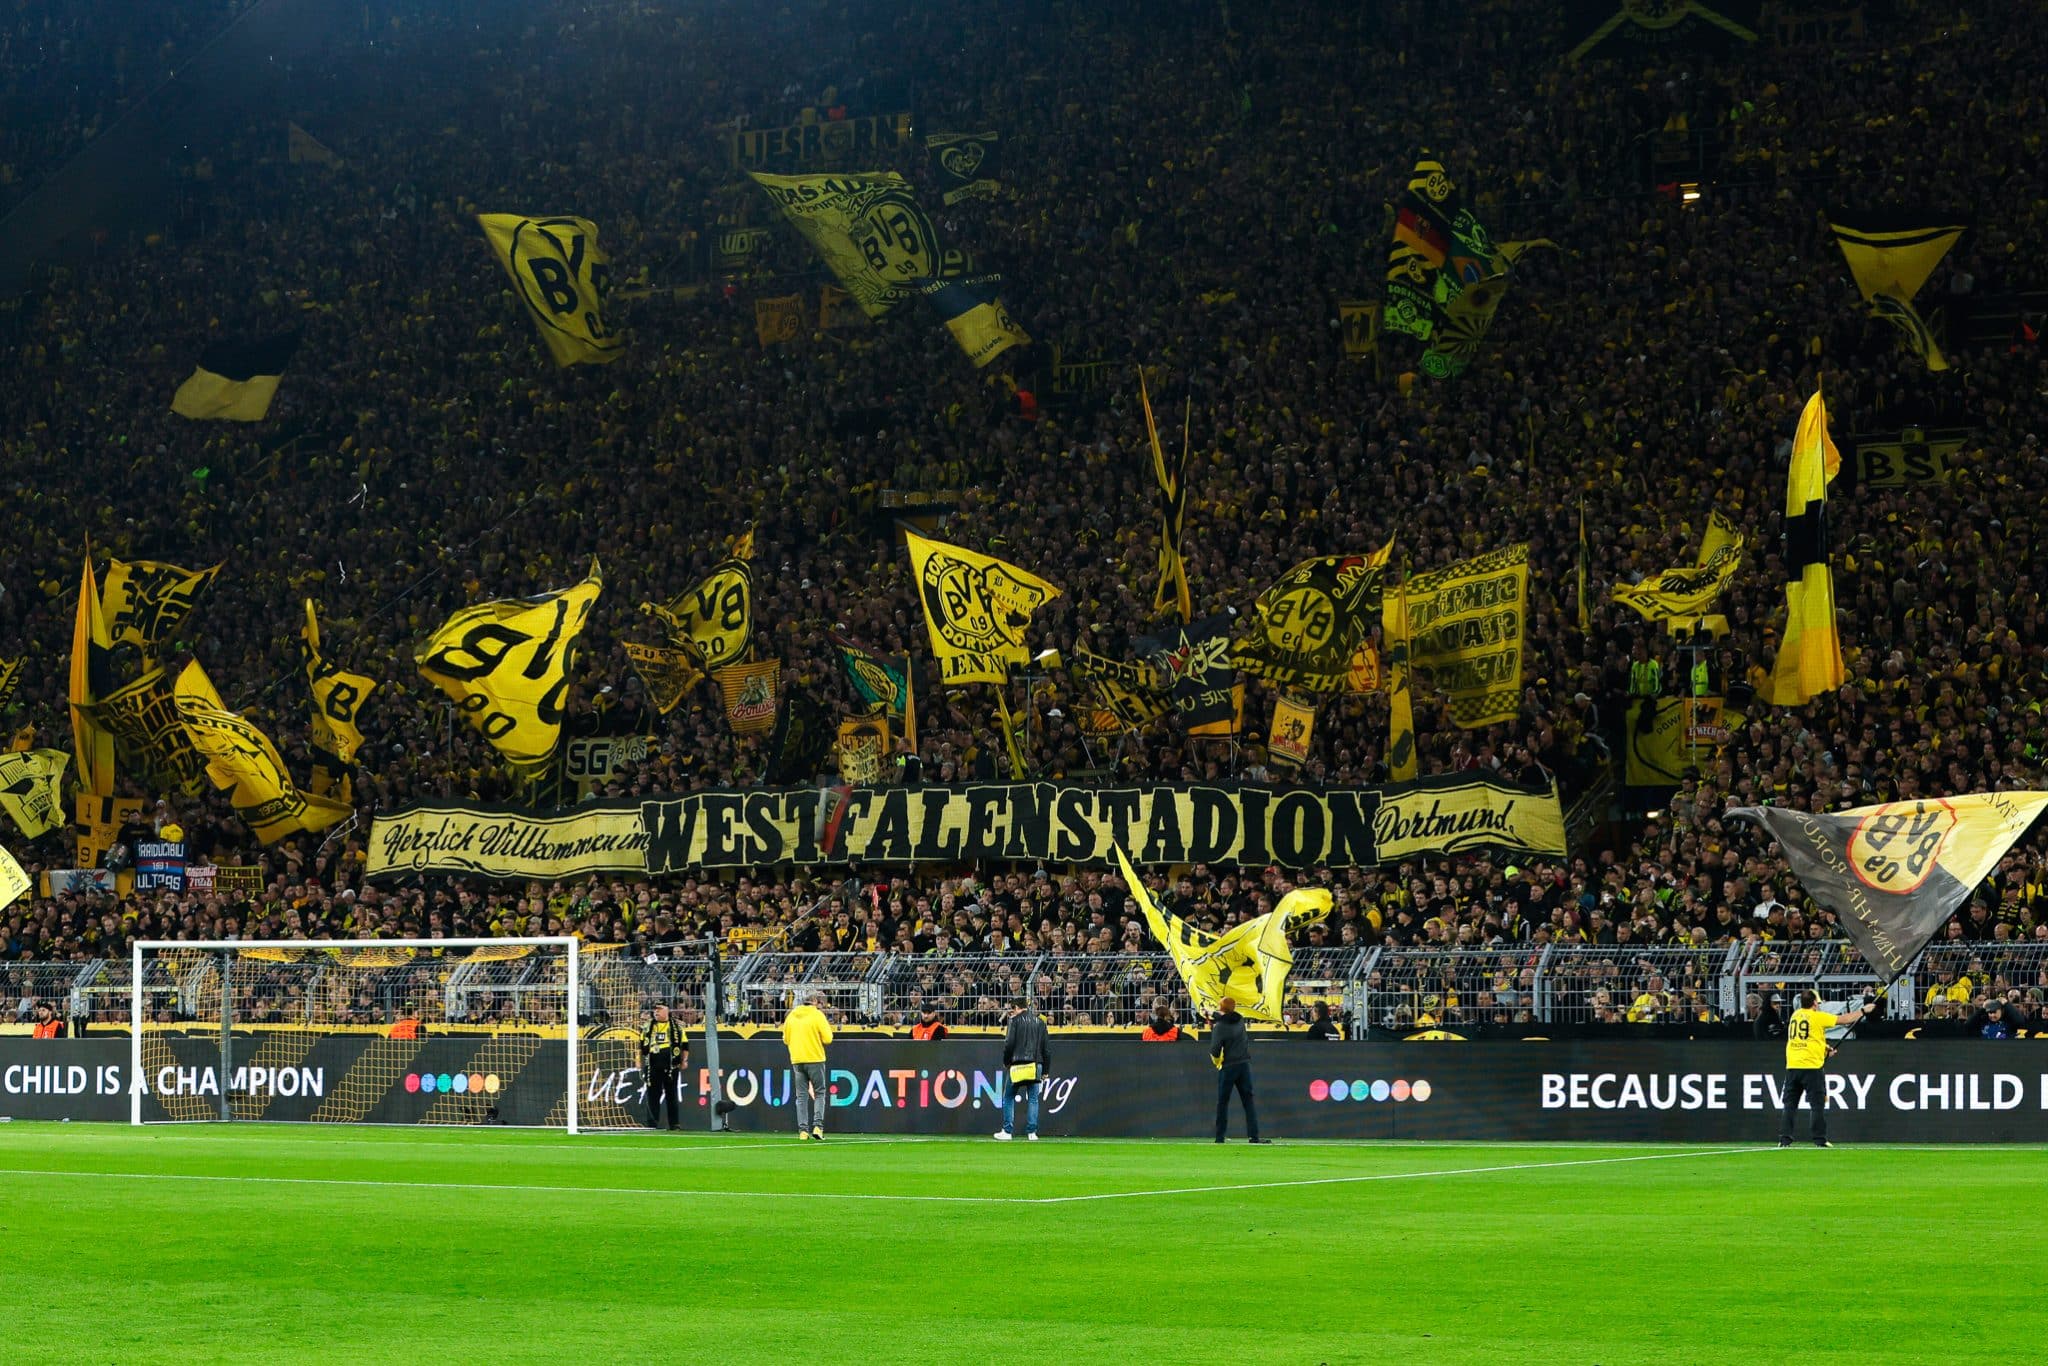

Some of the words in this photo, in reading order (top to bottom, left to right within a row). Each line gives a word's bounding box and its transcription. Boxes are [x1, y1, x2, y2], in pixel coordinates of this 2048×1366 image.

[863, 208, 918, 271] BVB
[970, 612, 988, 630] 09
[568, 743, 610, 776] SG
[383, 817, 480, 870] Herzlich
[479, 820, 615, 861] Willkommen
[641, 783, 1383, 874] WESTFALENSTADION
[1374, 799, 1516, 846] Dortmund
[1790, 1019, 1810, 1041] 09
[4, 1065, 87, 1094] CHILD
[97, 1065, 120, 1095] IS
[1541, 1073, 1728, 1110] BECAUSE
[1743, 1073, 1876, 1110] EVRY
[1889, 1073, 2025, 1111] CHILD
